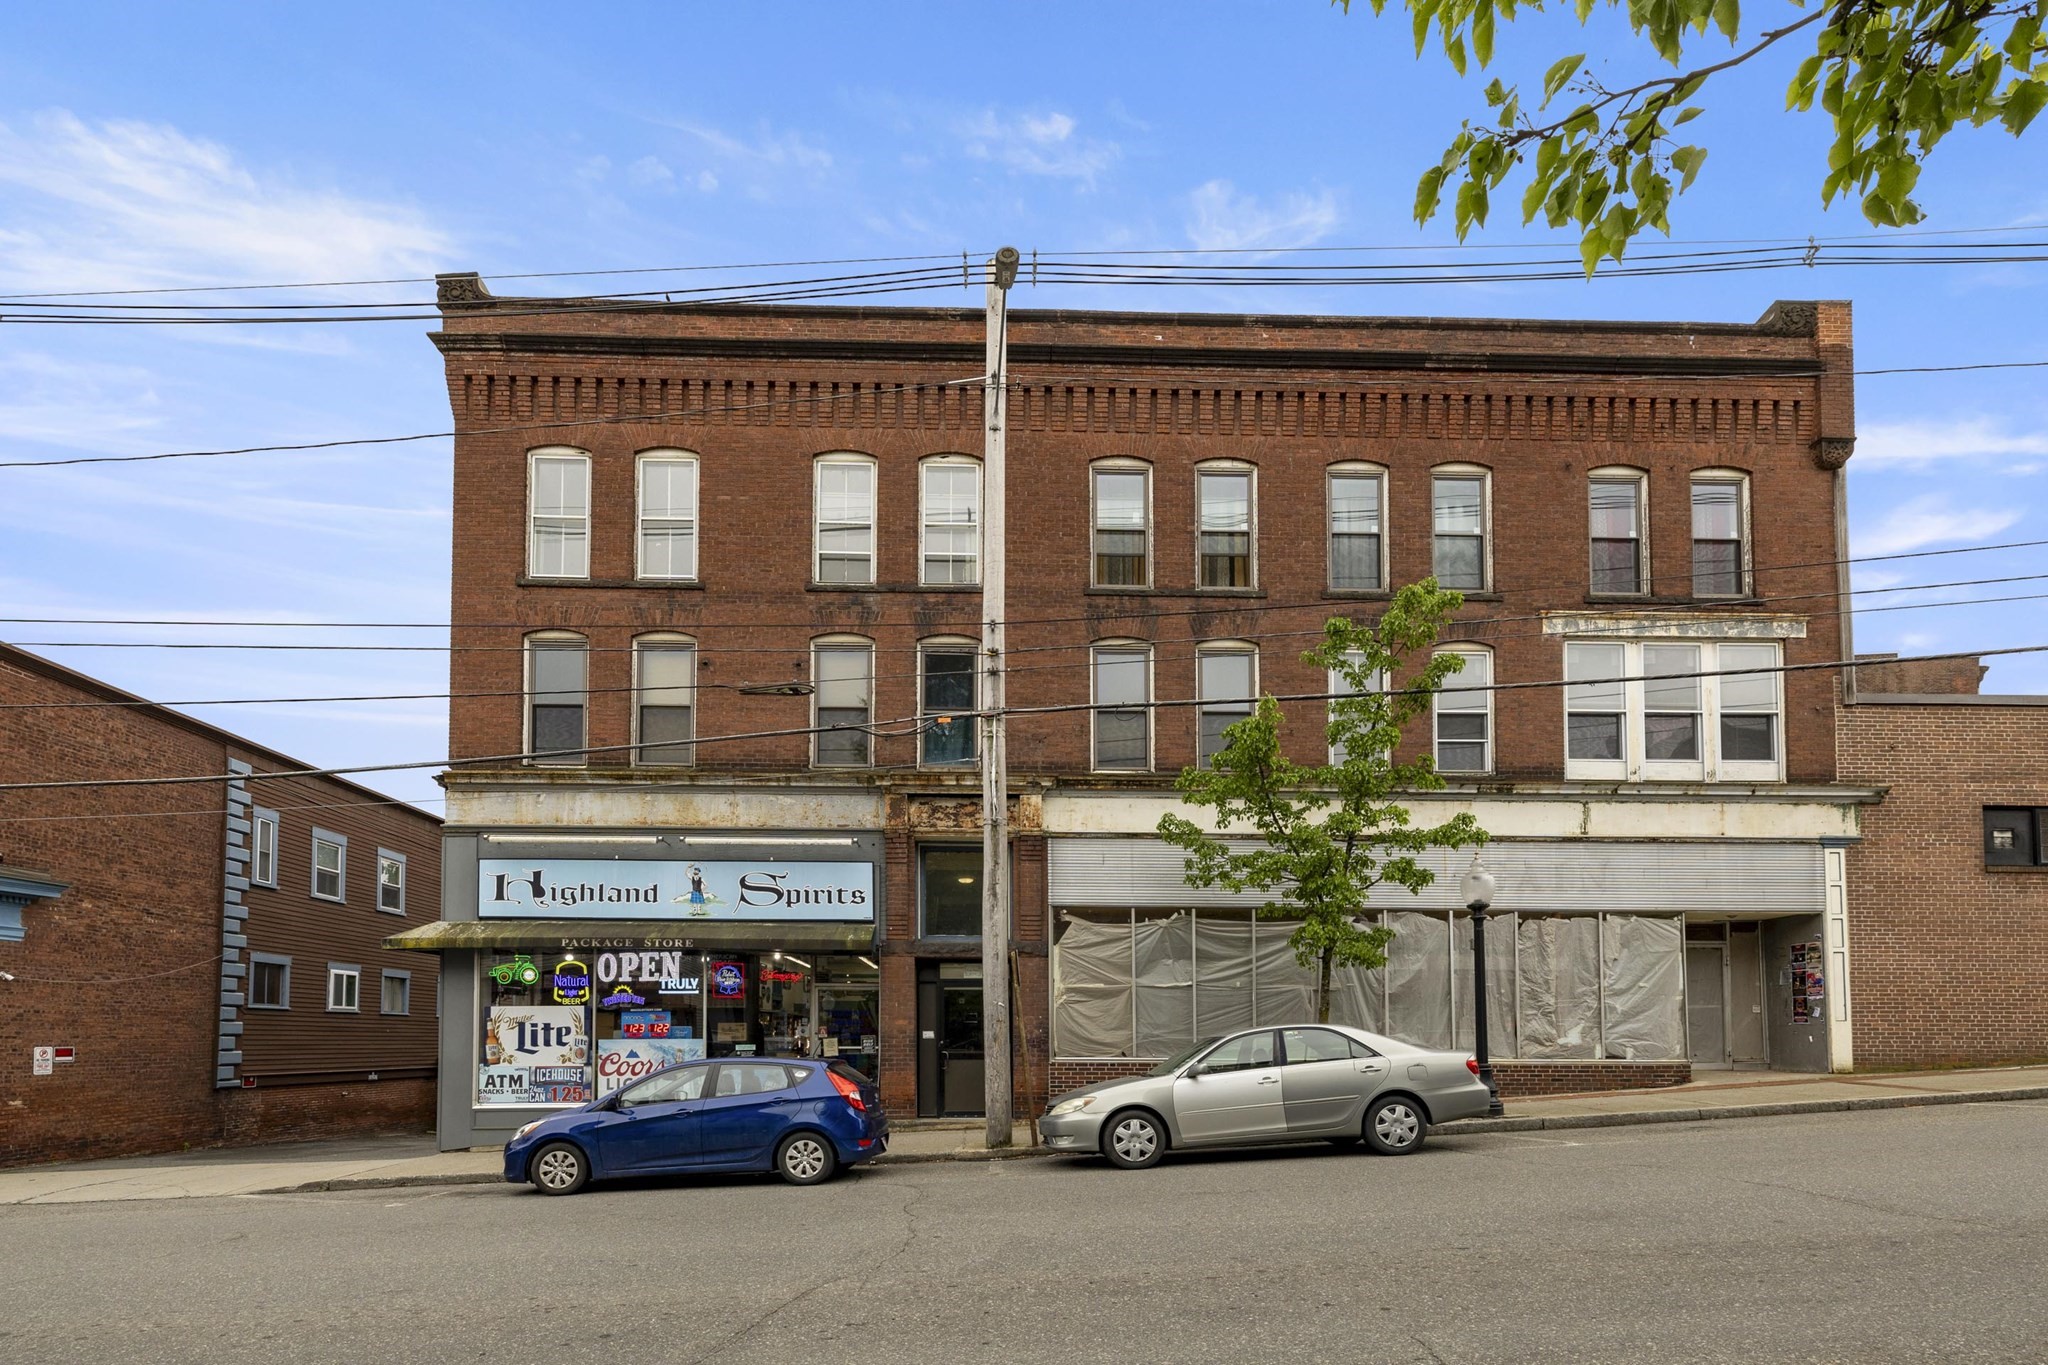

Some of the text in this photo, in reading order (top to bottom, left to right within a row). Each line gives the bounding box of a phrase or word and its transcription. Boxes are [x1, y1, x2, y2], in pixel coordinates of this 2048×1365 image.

[486, 869, 866, 913] Highland Spirits
[561, 938, 694, 948] PACKAGE STORE
[597, 952, 682, 983] OPEN
[554, 974, 590, 987] Natural
[659, 978, 699, 990] TRULY
[503, 1014, 535, 1031] Miller
[514, 1021, 572, 1055] Lite
[484, 1074, 524, 1088] ATM
[536, 1068, 583, 1083] ICEHOUSE
[529, 1092, 546, 1102] CAN
